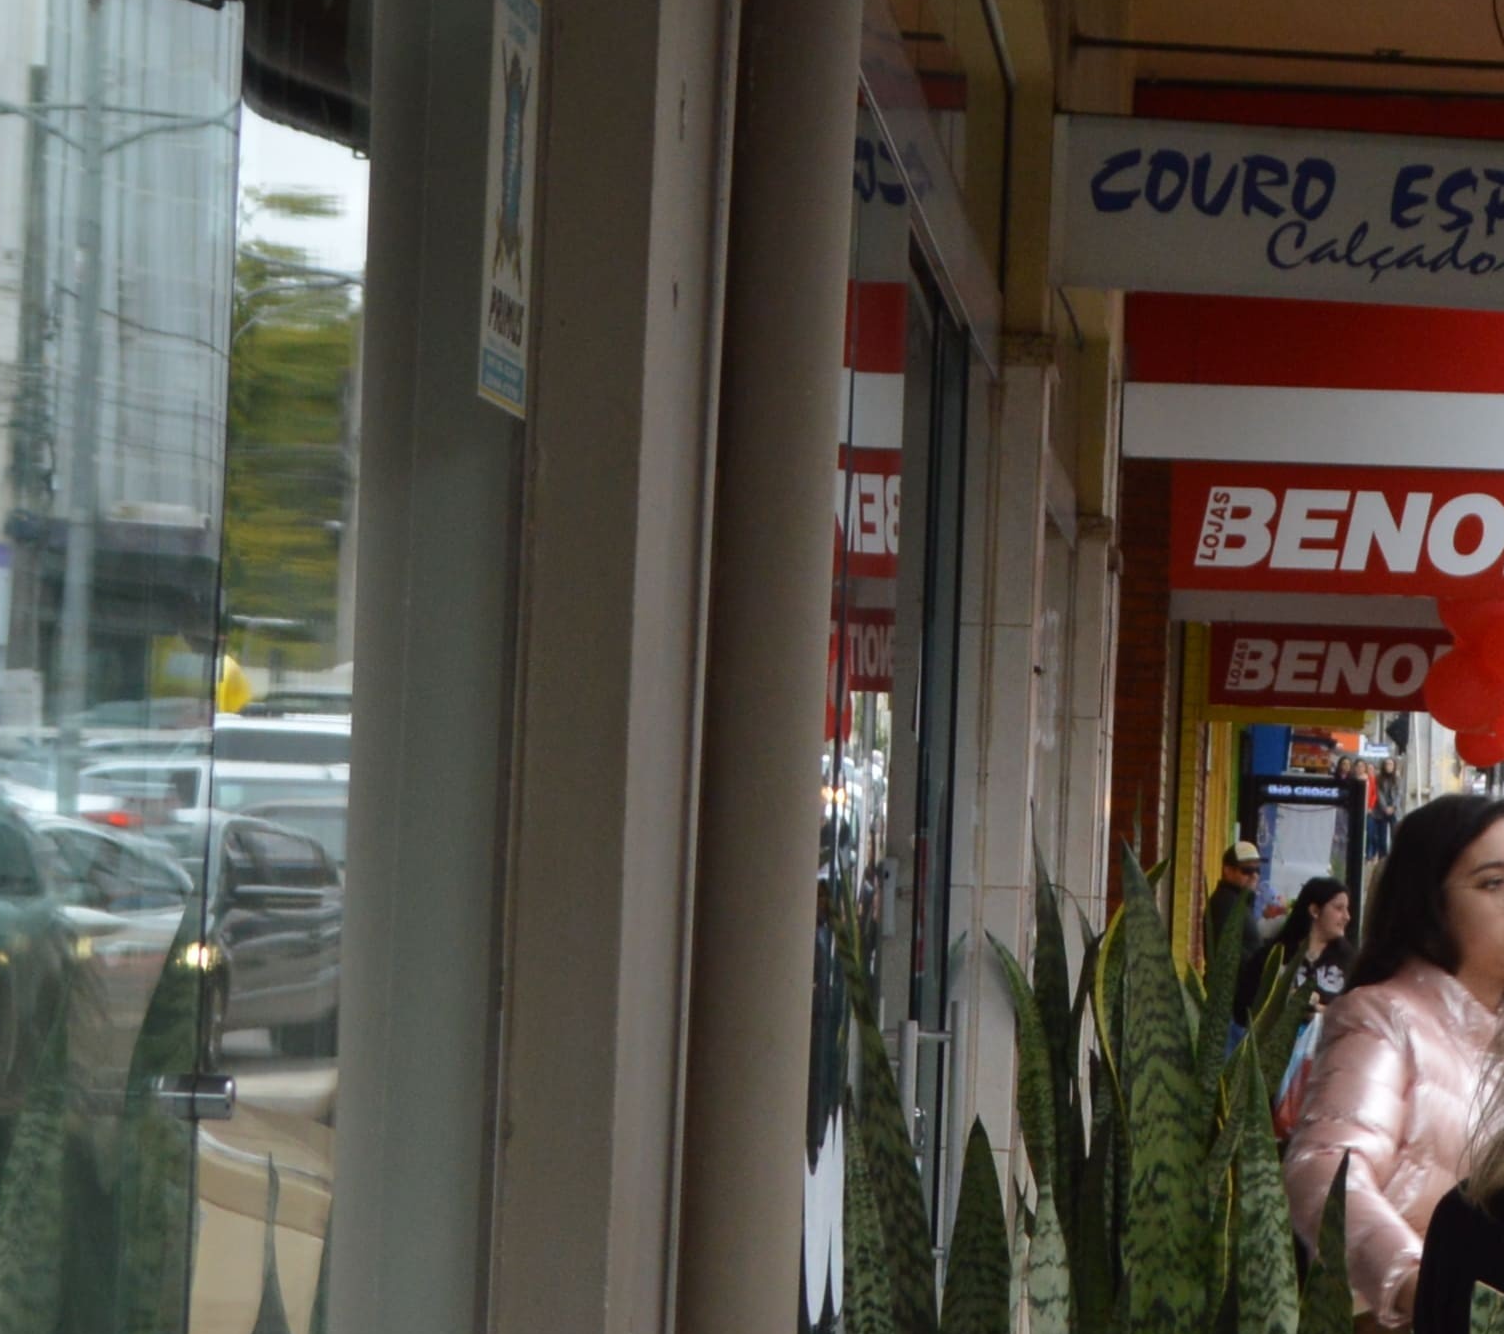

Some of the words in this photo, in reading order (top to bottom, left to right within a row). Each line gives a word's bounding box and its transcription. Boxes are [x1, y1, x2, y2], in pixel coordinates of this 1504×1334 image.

[1091, 148, 1337, 222] COURO
[1198, 490, 1232, 562] LOJAS
[1224, 637, 1453, 697] BENO
